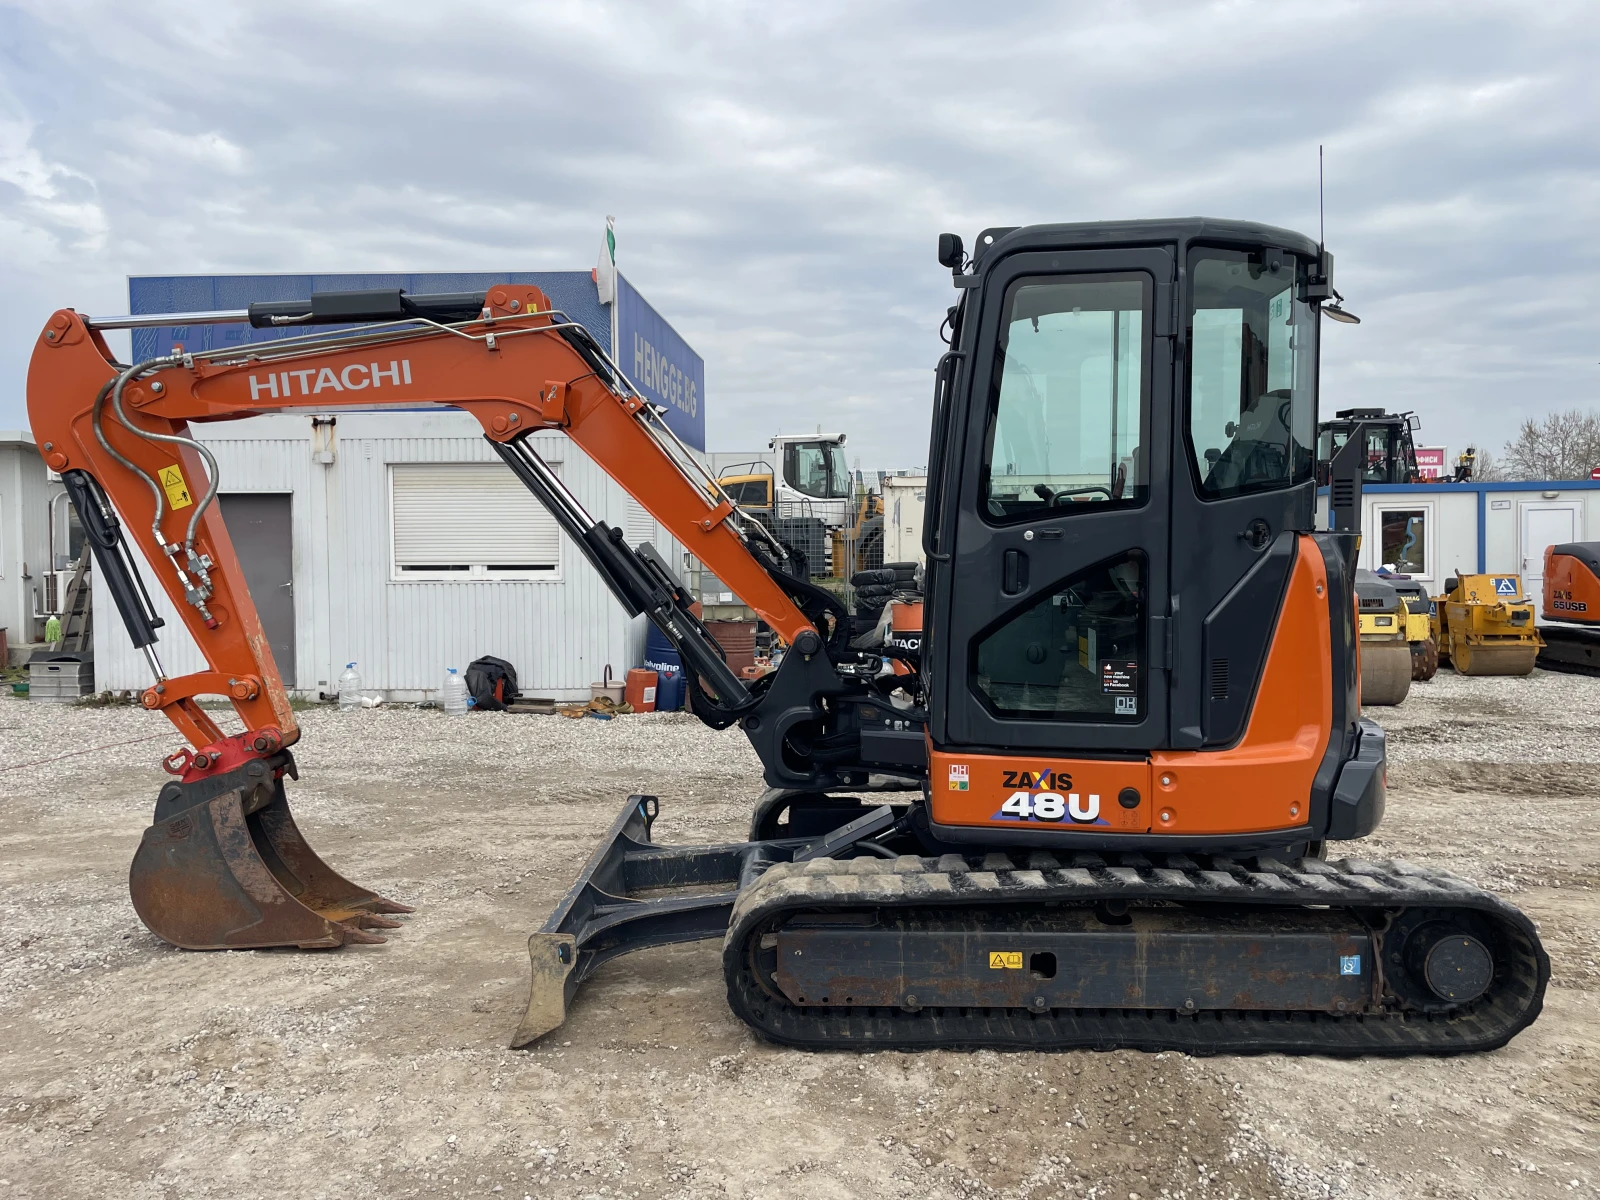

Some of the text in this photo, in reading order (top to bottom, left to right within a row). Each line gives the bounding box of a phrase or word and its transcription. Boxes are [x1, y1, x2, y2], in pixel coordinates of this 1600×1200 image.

[249, 359, 412, 400] HITACHI
[634, 331, 697, 418] HENGGE.BG
[1553, 590, 1573, 600] ZAXIS
[1553, 601, 1587, 612] 65USB
[1002, 769, 1073, 791] ZAXIS
[1001, 792, 1100, 824] 48U
